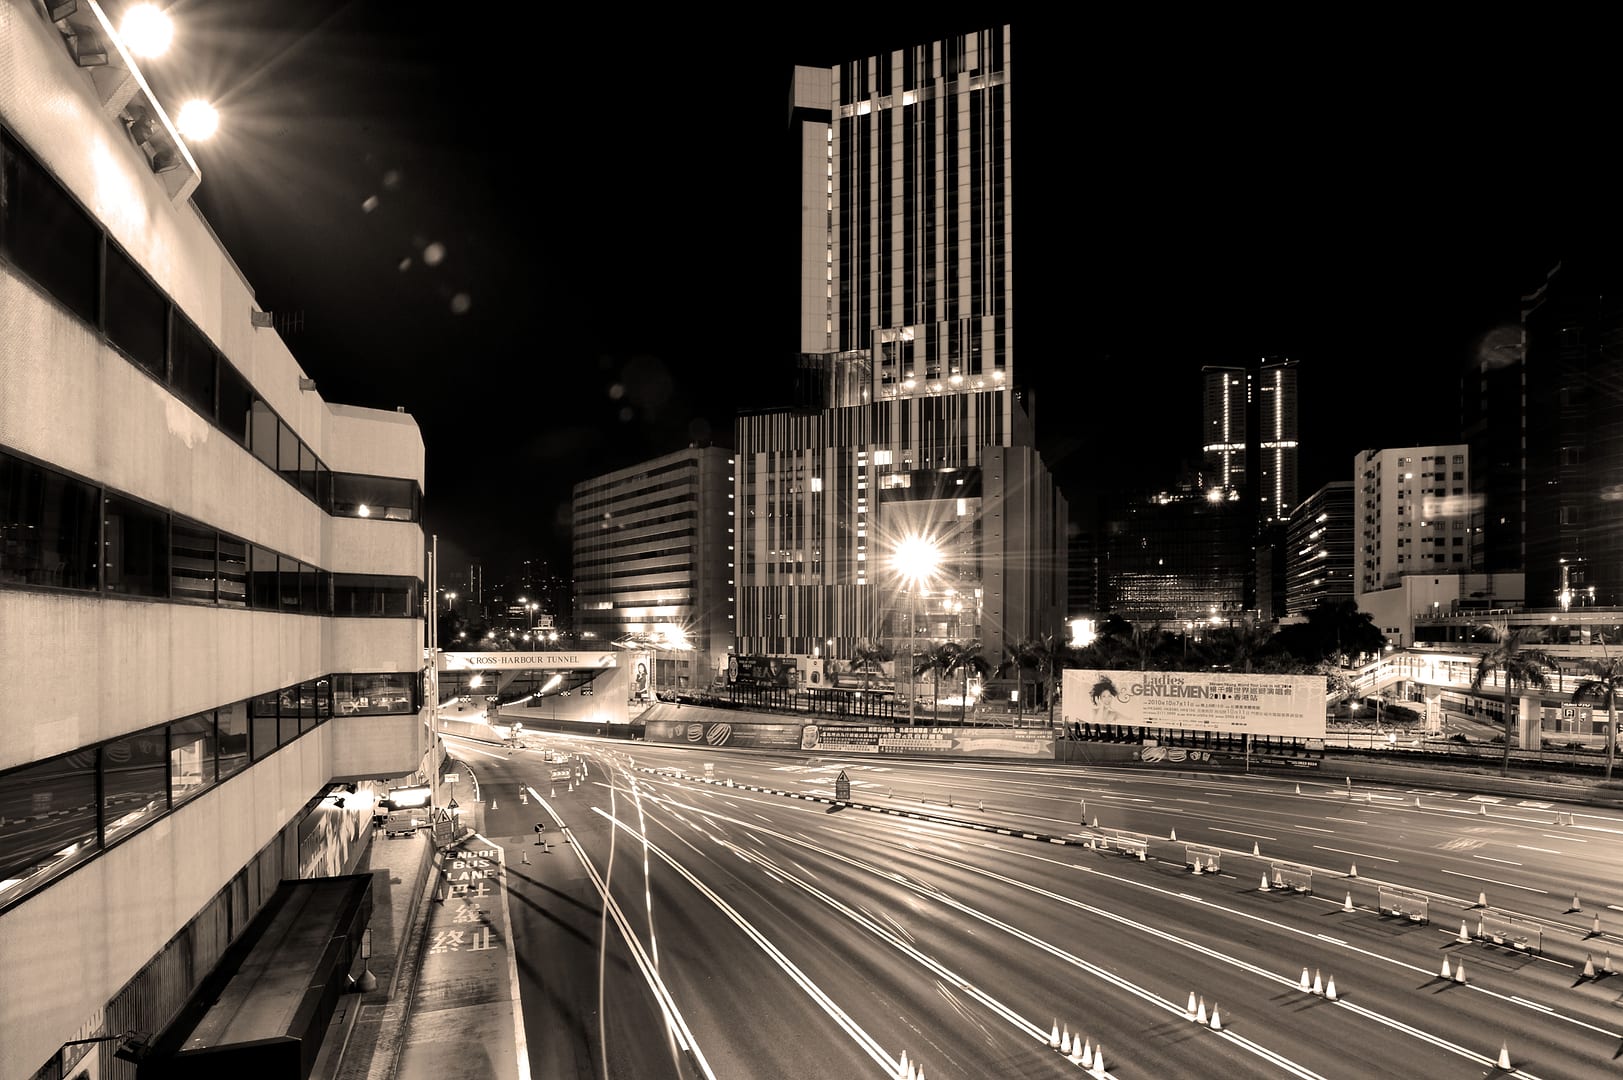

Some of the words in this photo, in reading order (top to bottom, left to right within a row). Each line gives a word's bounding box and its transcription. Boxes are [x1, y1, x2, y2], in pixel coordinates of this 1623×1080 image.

[469, 656, 543, 665] CROSS-HARBOUR
[547, 655, 579, 664] TUNNEL
[1143, 674, 1185, 685] Ladies
[1131, 683, 1209, 699] GENTLEMEN
[445, 851, 478, 860] END
[479, 849, 498, 858] OF
[452, 859, 490, 869] BUS
[446, 869, 495, 881] LANE
[446, 882, 491, 900] 巴士
[429, 926, 498, 954] 終止
